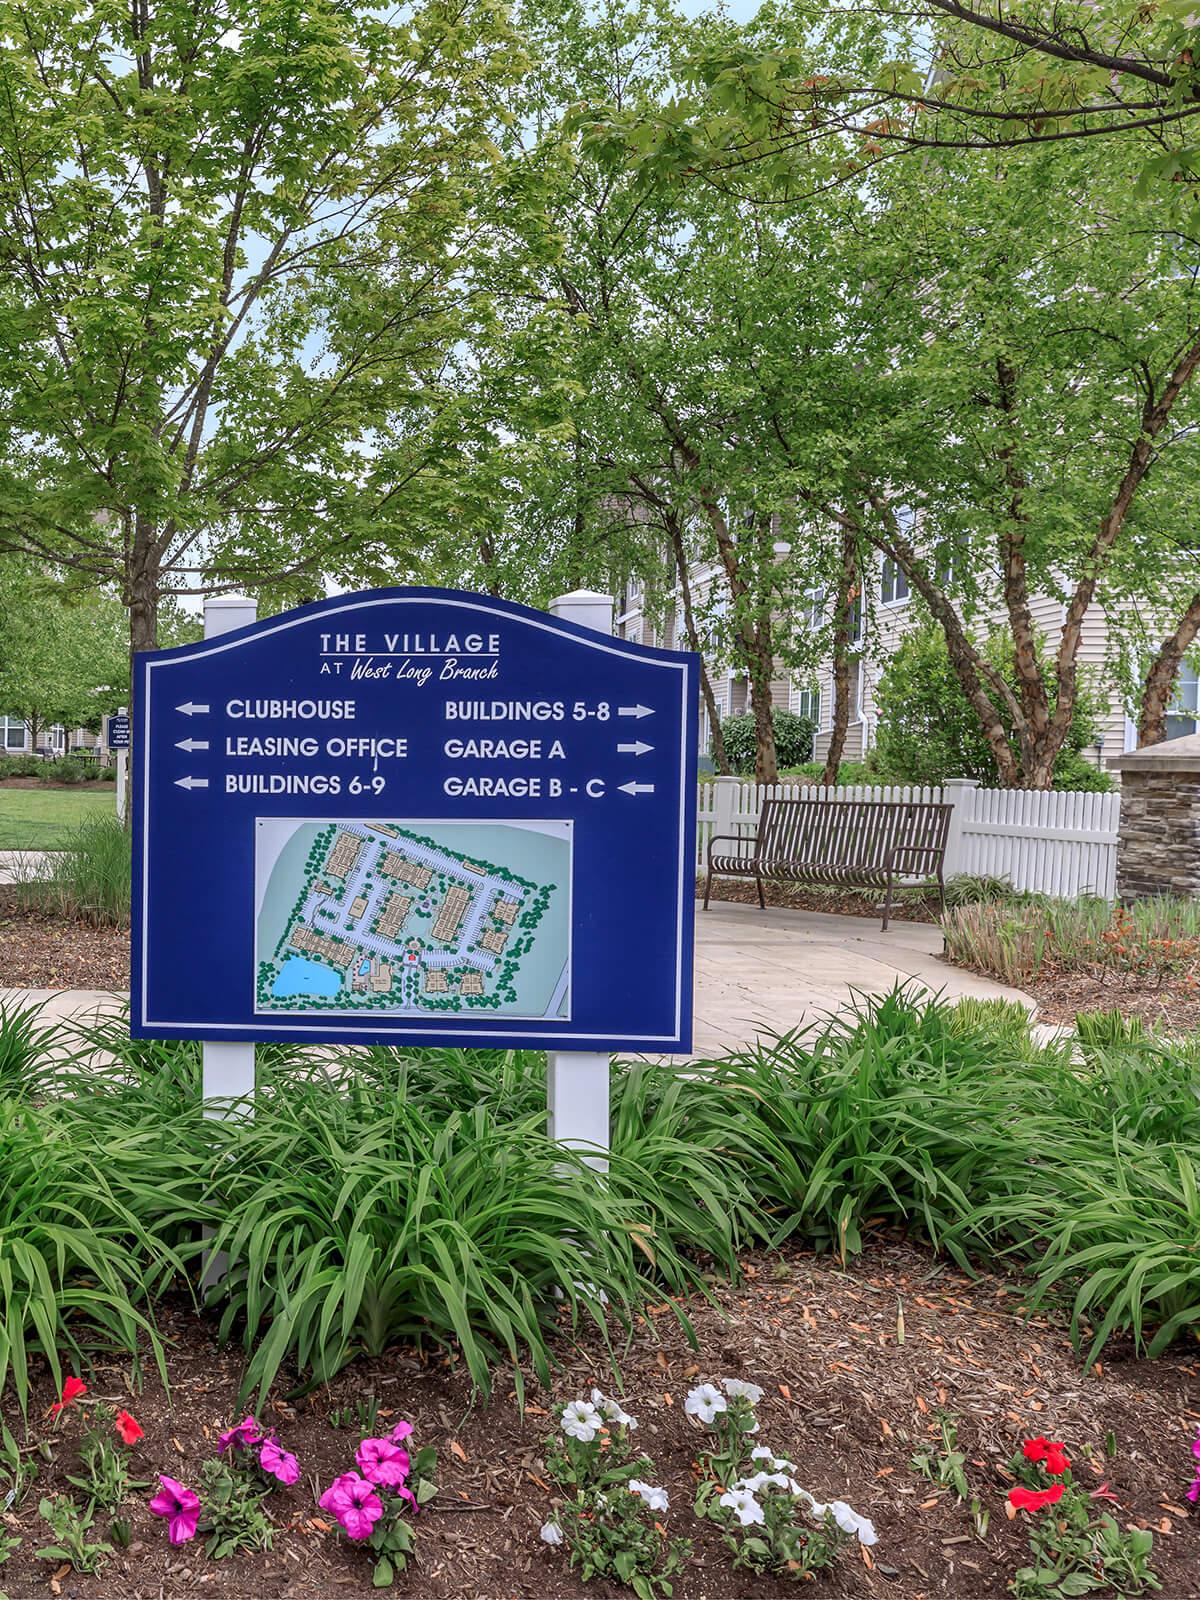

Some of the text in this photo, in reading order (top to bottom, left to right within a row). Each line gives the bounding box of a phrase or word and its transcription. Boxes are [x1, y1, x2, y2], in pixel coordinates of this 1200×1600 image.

[320, 634, 499, 652] THE VILLAGE
[320, 657, 498, 686] AT West Long Branch
[227, 700, 355, 719] CLUBHOUSE
[446, 701, 610, 721] BUILDINGS 5-8
[226, 737, 408, 757] LEASING OFFICE
[444, 739, 566, 759] GARAGE A
[226, 775, 385, 794] BUILDINGS 6-9
[444, 777, 540, 796] GARAGE
[550, 779, 562, 797] B
[586, 779, 605, 797] C
